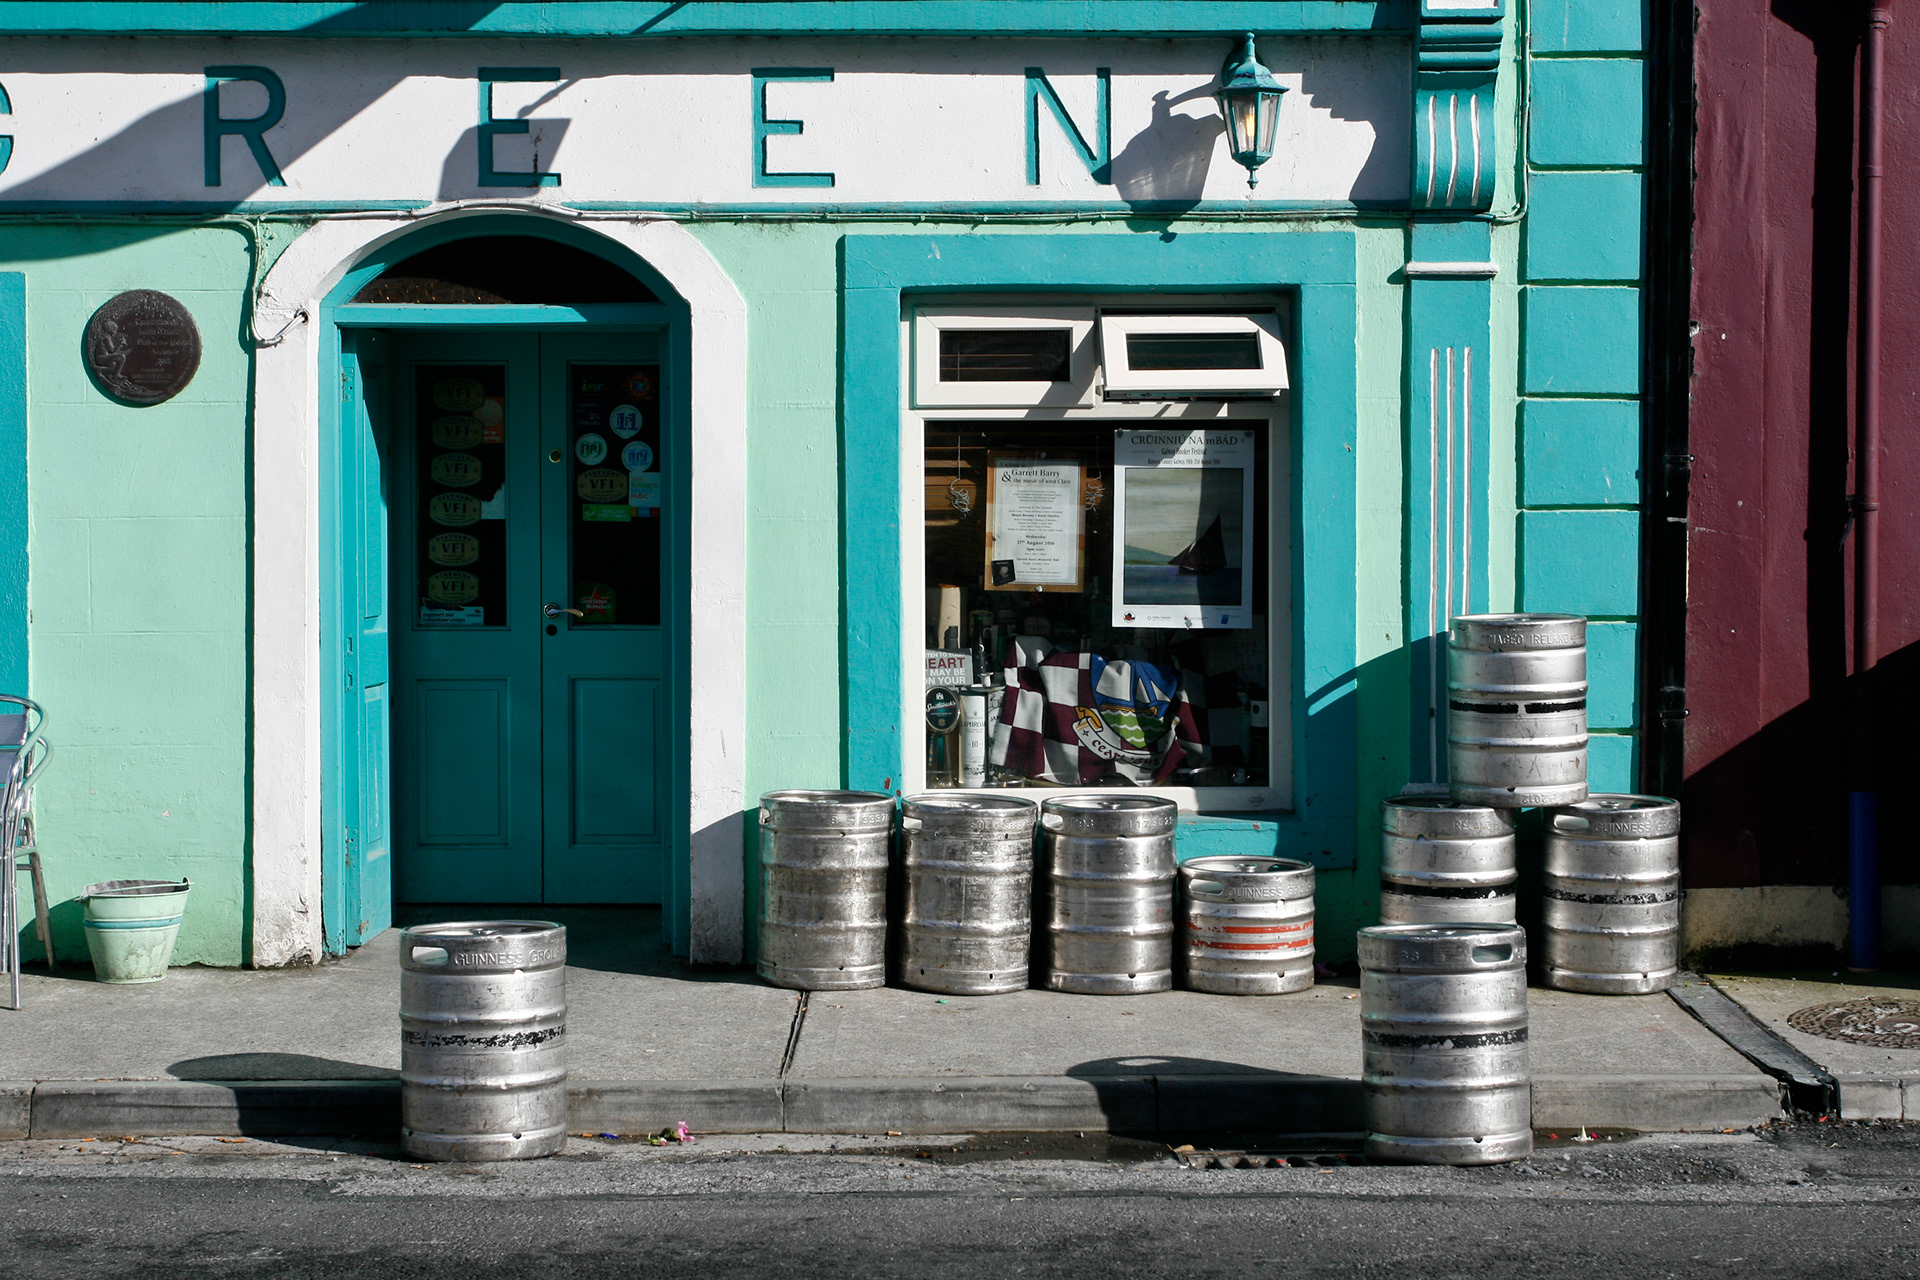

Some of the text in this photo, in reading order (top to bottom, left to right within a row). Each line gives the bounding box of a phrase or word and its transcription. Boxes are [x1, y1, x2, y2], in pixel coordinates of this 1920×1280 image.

[1188, 436, 1204, 445] NA
[444, 463, 469, 474] VFI
[1011, 469, 1060, 479] Garrett Barry
[1001, 471, 1012, 483] &
[590, 479, 614, 489] VFI
[443, 502, 467, 513] VFI
[441, 543, 465, 553] VFI
[440, 580, 465, 592] VFI
[1530, 633, 1571, 645] IRELAND
[925, 657, 966, 669] EART
[930, 669, 951, 677] MAY
[953, 668, 966, 676] BE
[937, 676, 966, 685] YOUR
[1594, 821, 1652, 834] GUINNESS
[1227, 886, 1285, 898] GUINNESS
[454, 951, 524, 967] GUINNESS
